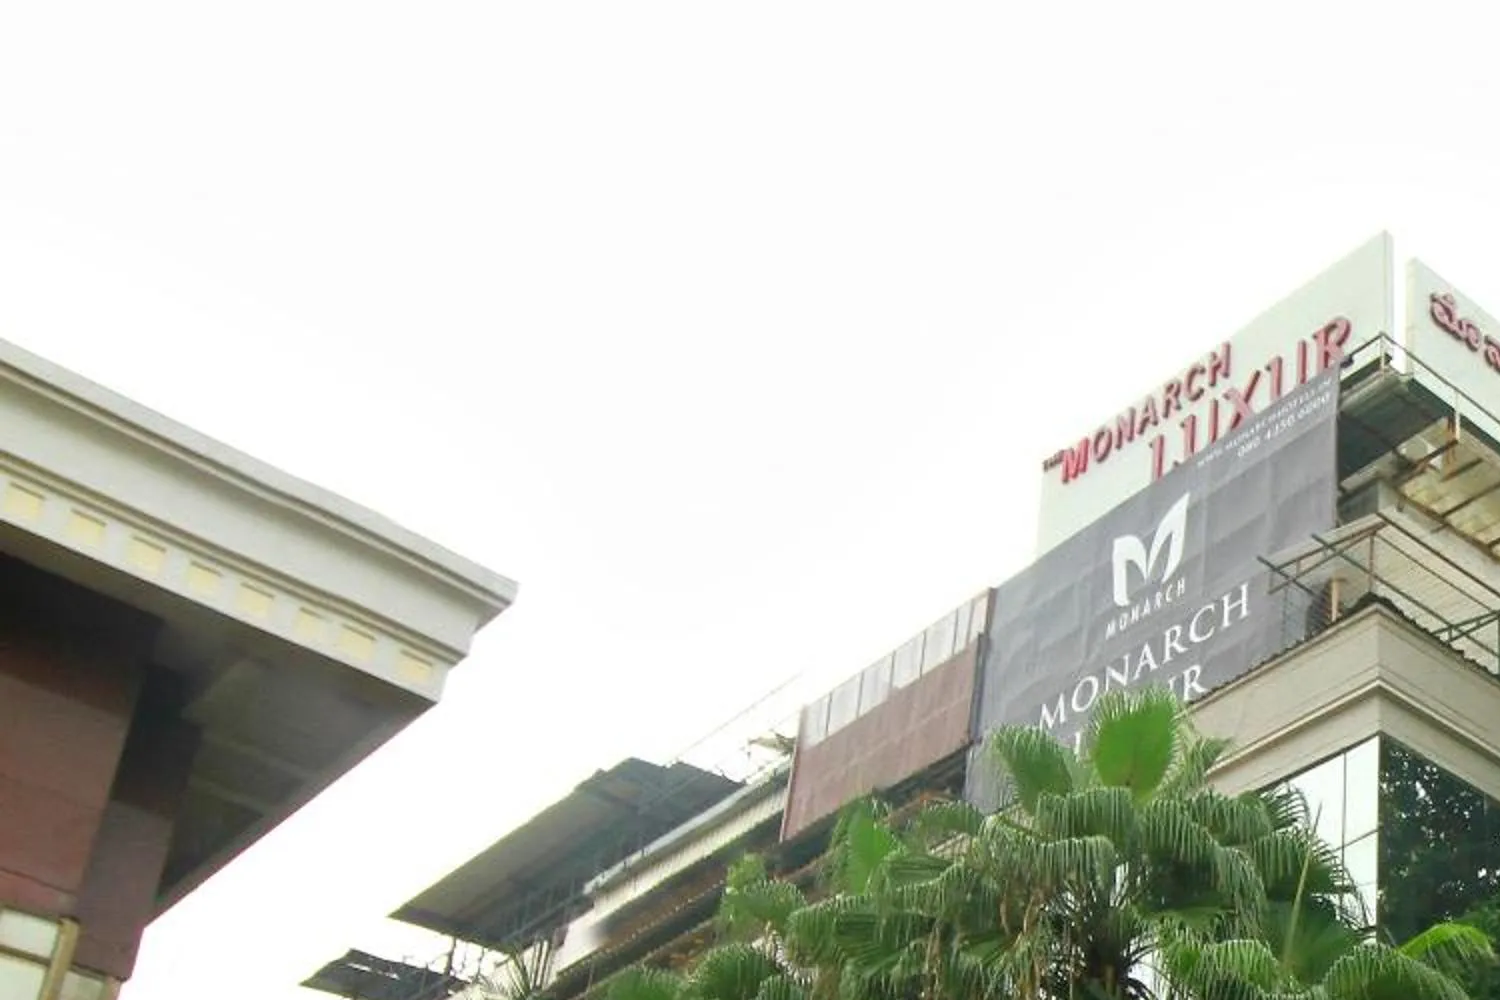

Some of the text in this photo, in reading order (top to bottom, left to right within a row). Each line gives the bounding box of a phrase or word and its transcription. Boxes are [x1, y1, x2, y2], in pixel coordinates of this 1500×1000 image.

[1061, 341, 1231, 484] MONARCH
[1038, 583, 1249, 732] MONARCH
[1105, 577, 1186, 641] MONARCH
